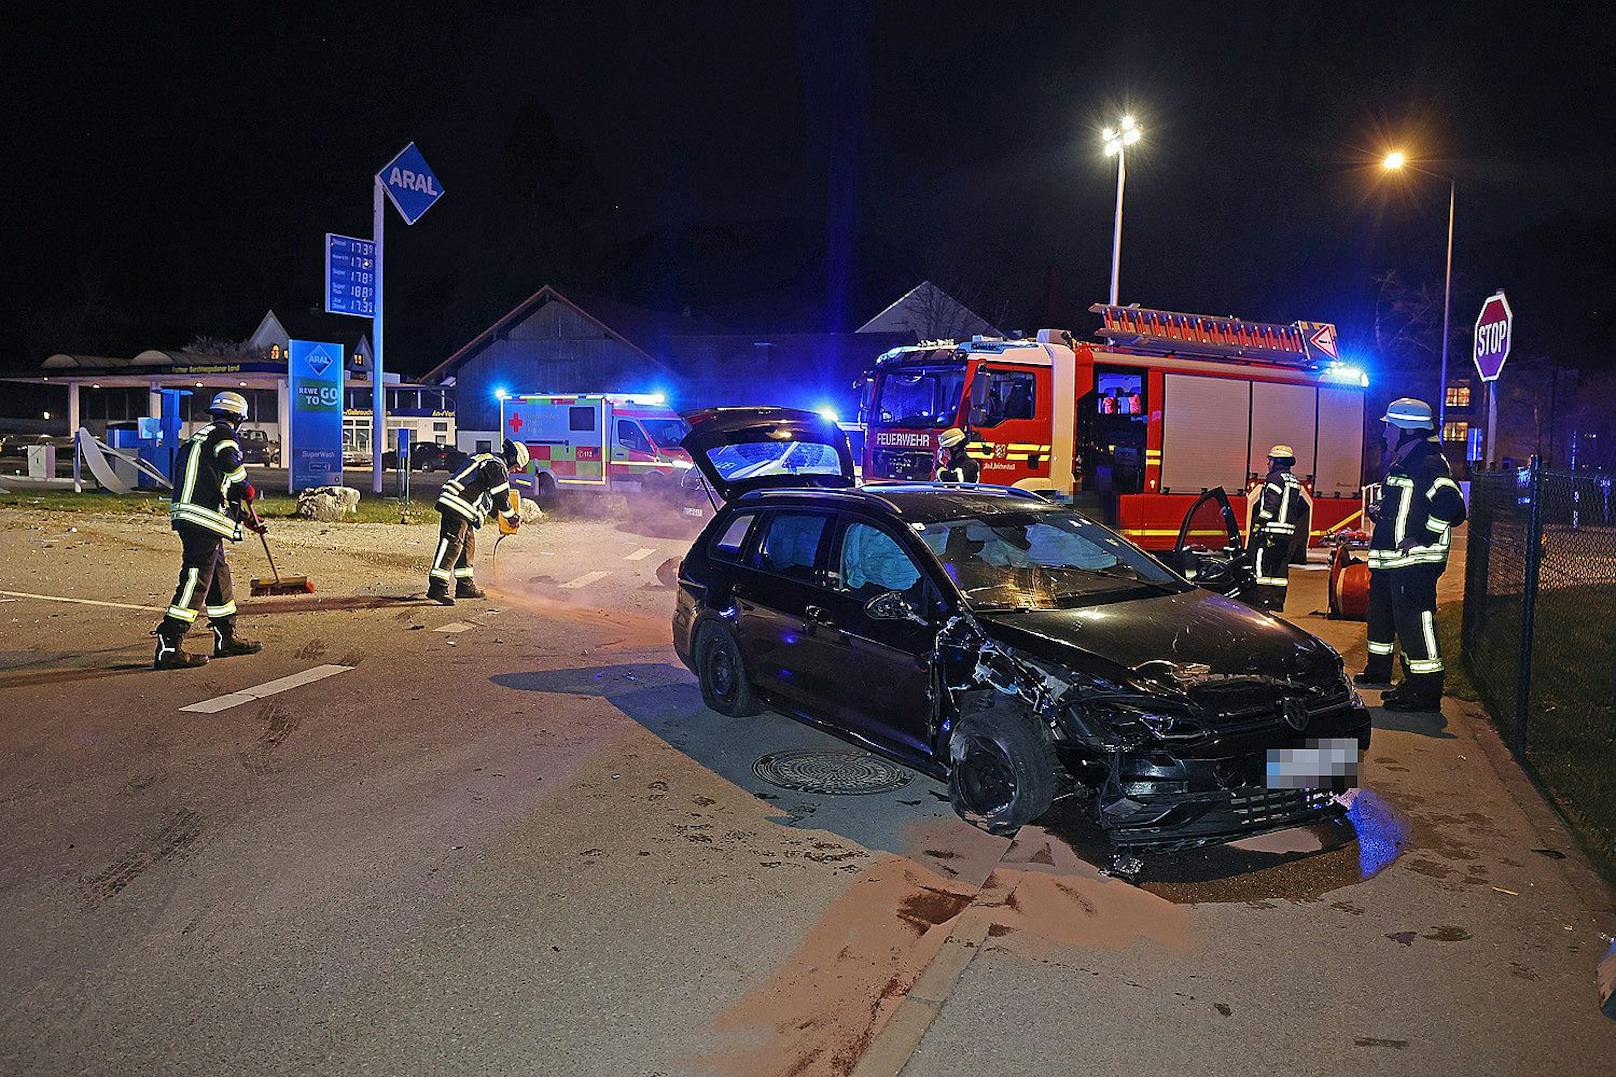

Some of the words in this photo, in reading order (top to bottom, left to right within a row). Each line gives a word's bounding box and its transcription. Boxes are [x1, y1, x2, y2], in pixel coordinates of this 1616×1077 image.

[389, 167, 438, 197] ARAL
[1477, 321, 1507, 358] STOP
[308, 355, 330, 365] ARAL
[299, 387, 319, 395] REWE
[320, 386, 338, 401] GO
[305, 396, 320, 406] TO
[876, 433, 931, 448] FEUERWEHR
[302, 451, 336, 459] SuperWash
